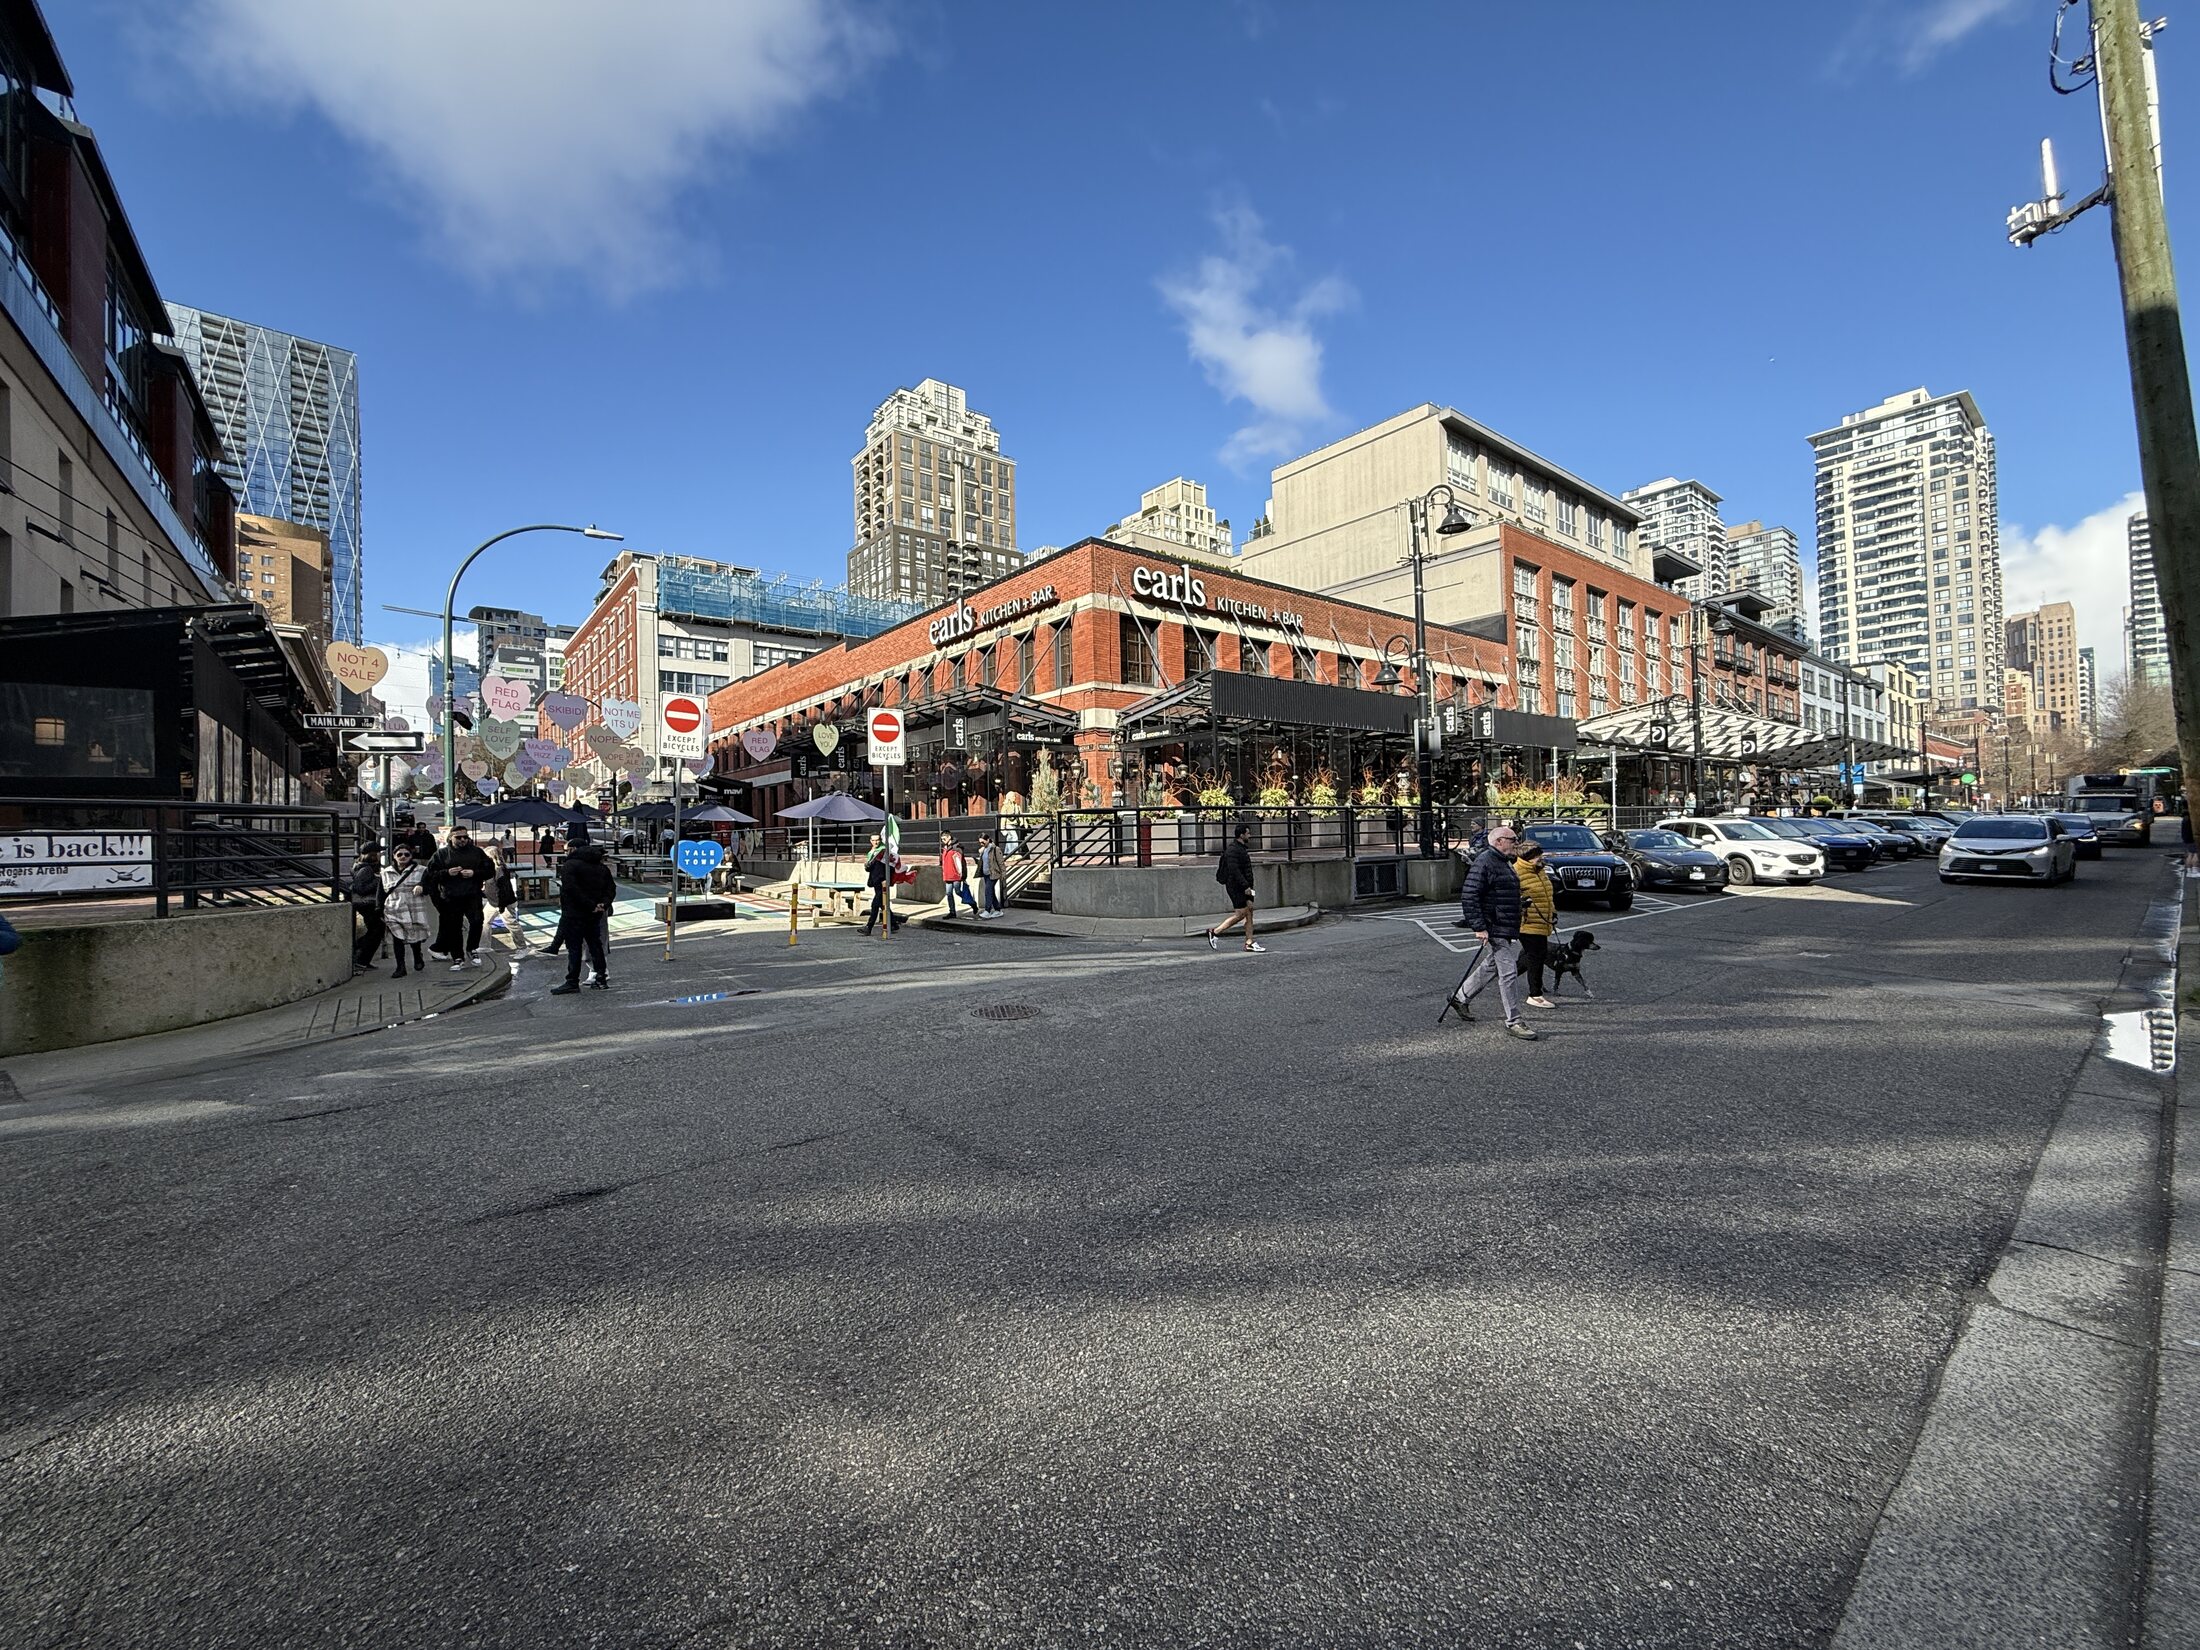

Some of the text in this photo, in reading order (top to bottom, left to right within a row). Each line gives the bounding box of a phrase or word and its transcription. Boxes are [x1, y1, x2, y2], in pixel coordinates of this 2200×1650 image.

[1133, 564, 1207, 607] earls
[1217, 597, 1267, 620] KITCHEN
[1283, 611, 1303, 628] BAR
[929, 597, 973, 645] earls
[980, 598, 1021, 625] KITCHEN
[1031, 585, 1053, 606] BAR
[337, 652, 379, 668] NOT 4
[339, 666, 376, 681] SALE
[495, 686, 519, 699] RED
[491, 698, 521, 711] FLAG
[548, 705, 585, 716] SKIBIDI
[604, 707, 640, 719] NOT ME
[1443, 706, 1455, 732] earls
[310, 717, 356, 727] MAINLAND
[388, 722, 408, 730] LUV
[611, 720, 635, 729] ITS U
[1480, 711, 1492, 736] earls
[818, 731, 834, 739] LOVE
[953, 718, 964, 746] earls
[1016, 731, 1034, 741] earls
[485, 735, 511, 744] LOVE
[590, 735, 619, 744] NOPE
[667, 735, 696, 743] EXCEPT
[528, 743, 556, 751] MAJOR
[662, 742, 700, 752] BICYCLES
[555, 755, 569, 763] EH
[836, 746, 845, 768] earls
[798, 756, 807, 776] earls
[13, 838, 35, 858] is
[46, 833, 144, 858] back!!!
[0, 866, 69, 878] Rogers Arena
